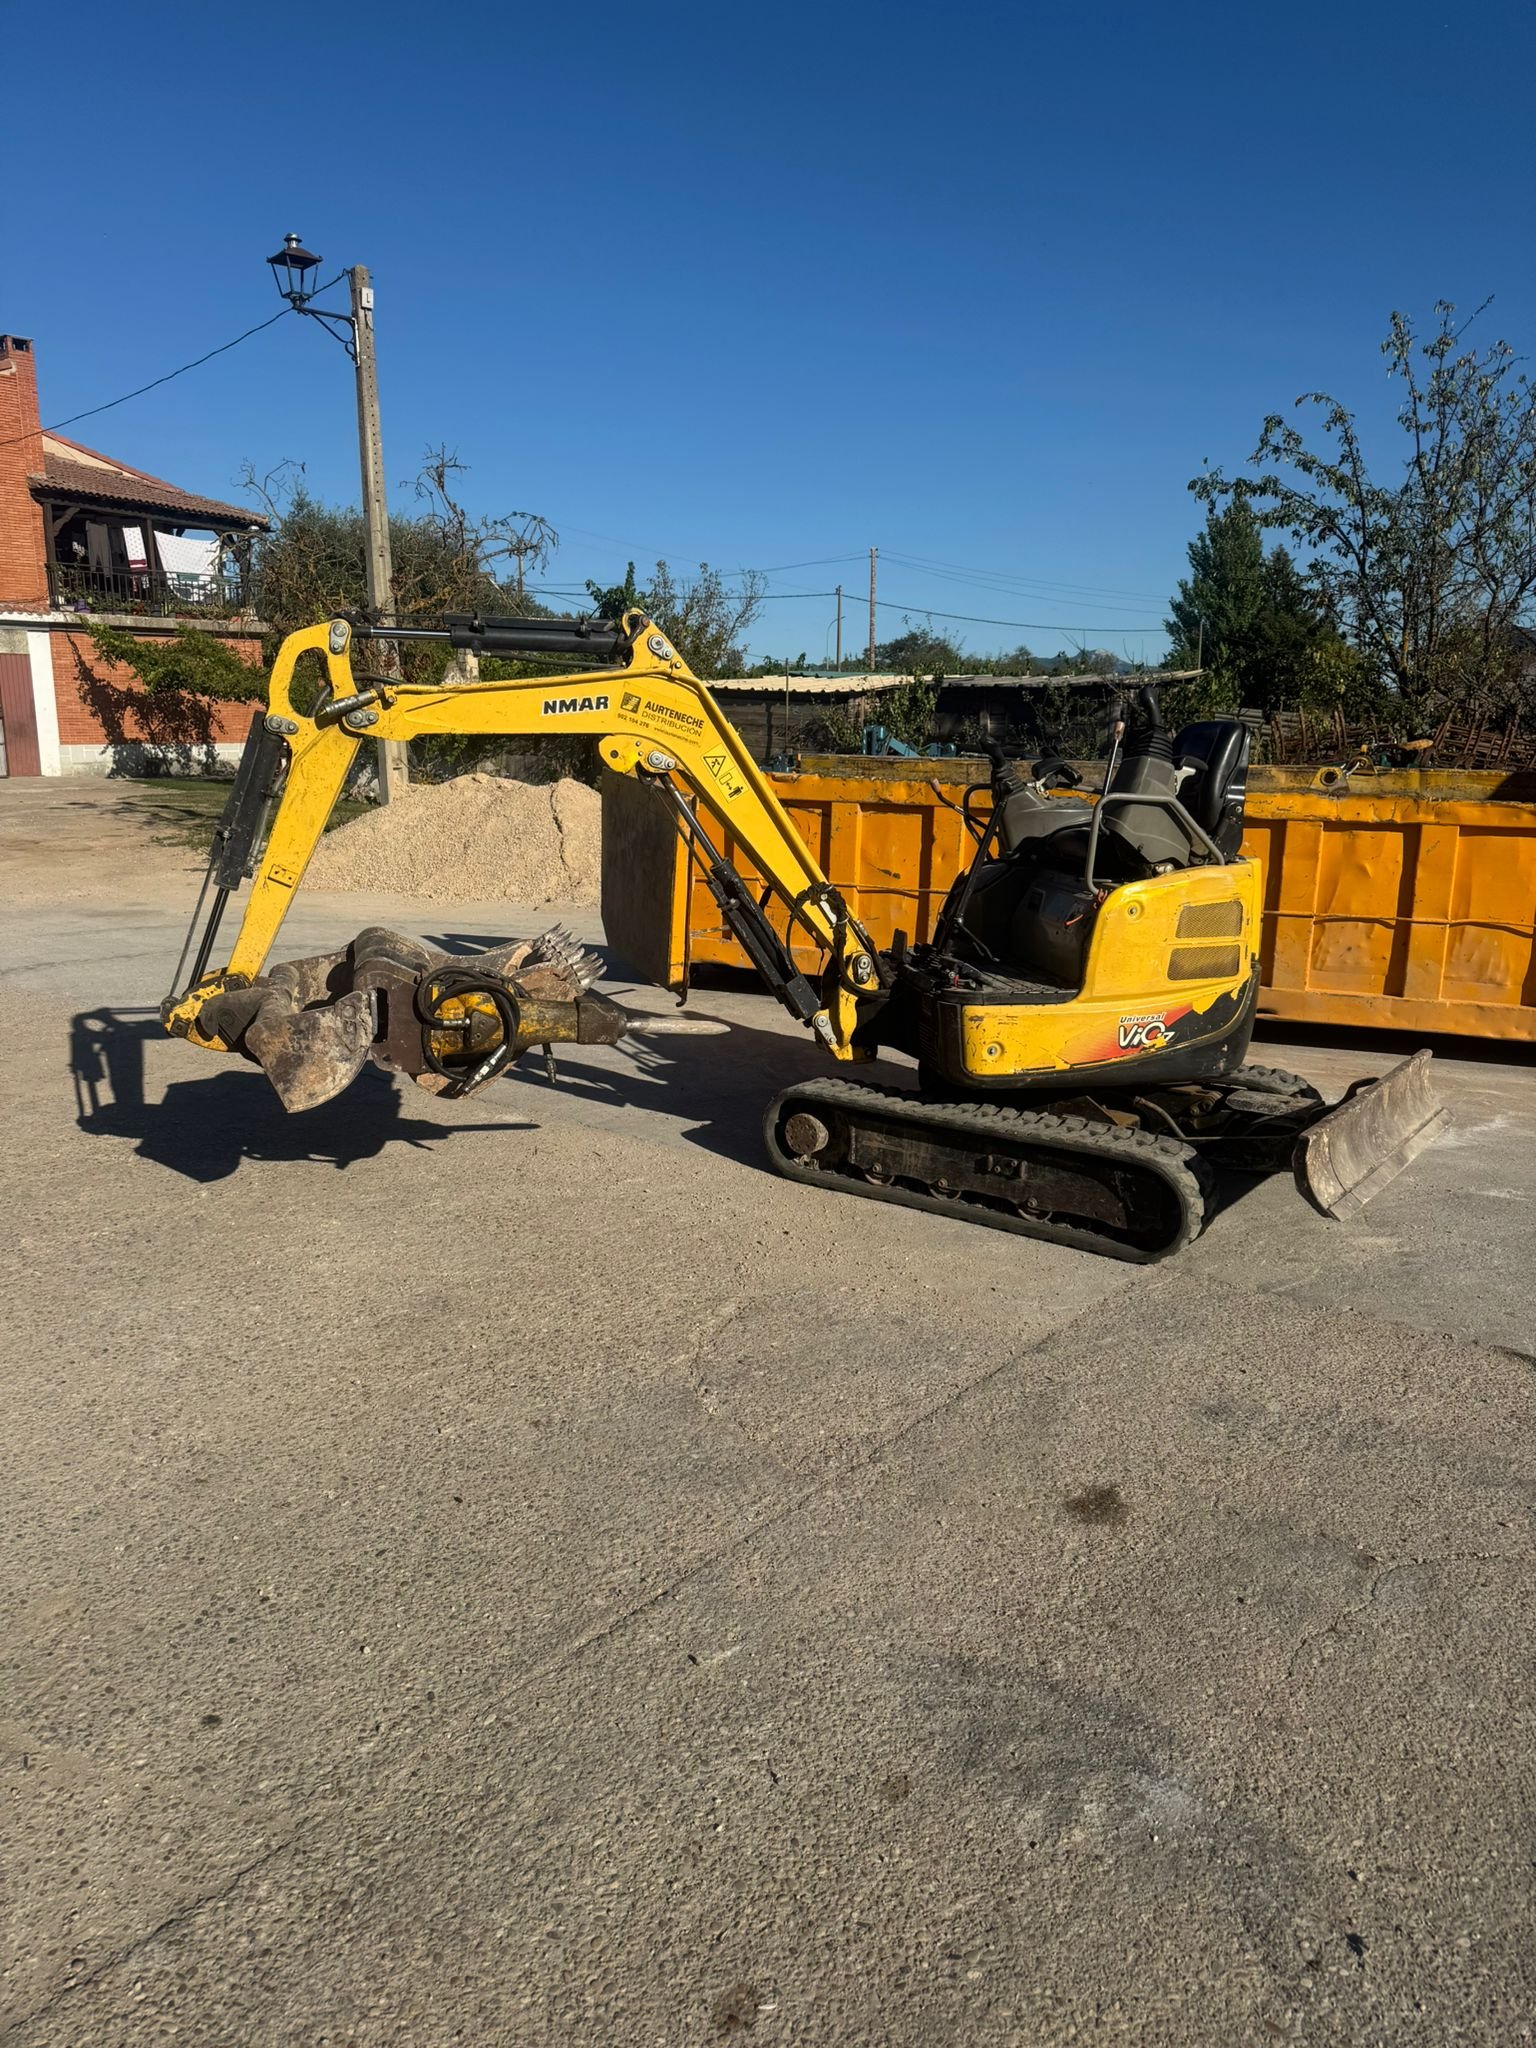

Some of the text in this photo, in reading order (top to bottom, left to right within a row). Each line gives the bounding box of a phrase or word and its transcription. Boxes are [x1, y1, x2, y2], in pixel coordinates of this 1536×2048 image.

[641, 710, 703, 737] DISTRIBUCIÓN
[644, 701, 705, 729] AURTENECHE
[1120, 1013, 1166, 1023] Universal
